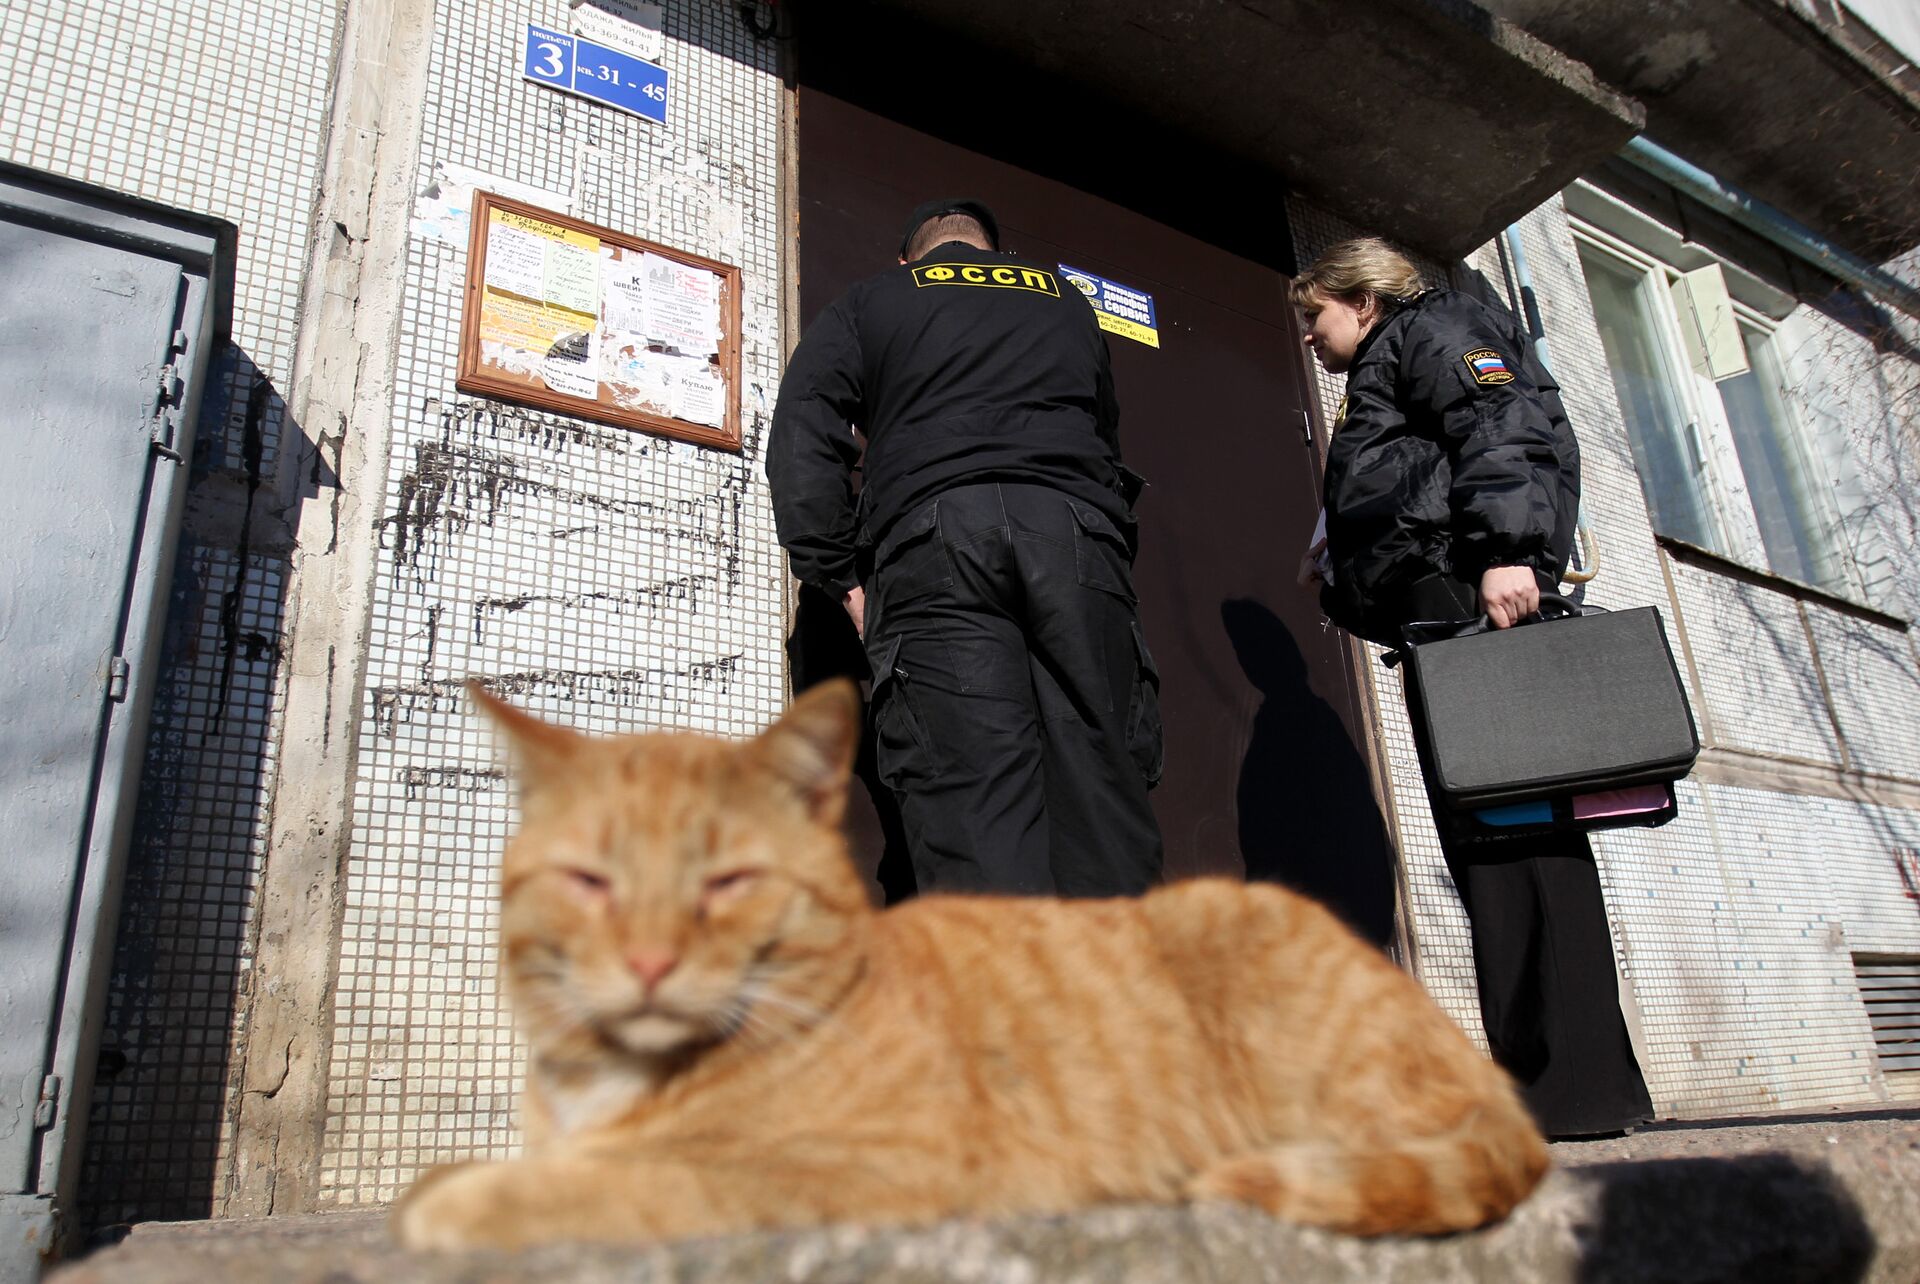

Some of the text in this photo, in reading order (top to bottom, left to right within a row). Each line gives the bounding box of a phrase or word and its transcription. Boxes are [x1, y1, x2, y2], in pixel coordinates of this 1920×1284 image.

[532, 29, 571, 48] подъезд
[533, 43, 564, 78] 3
[577, 65, 595, 77] кв.
[597, 65, 620, 86] 31
[642, 83, 665, 102] 45
[925, 267, 1048, 290] ФССП
[681, 378, 714, 392] Куплю
